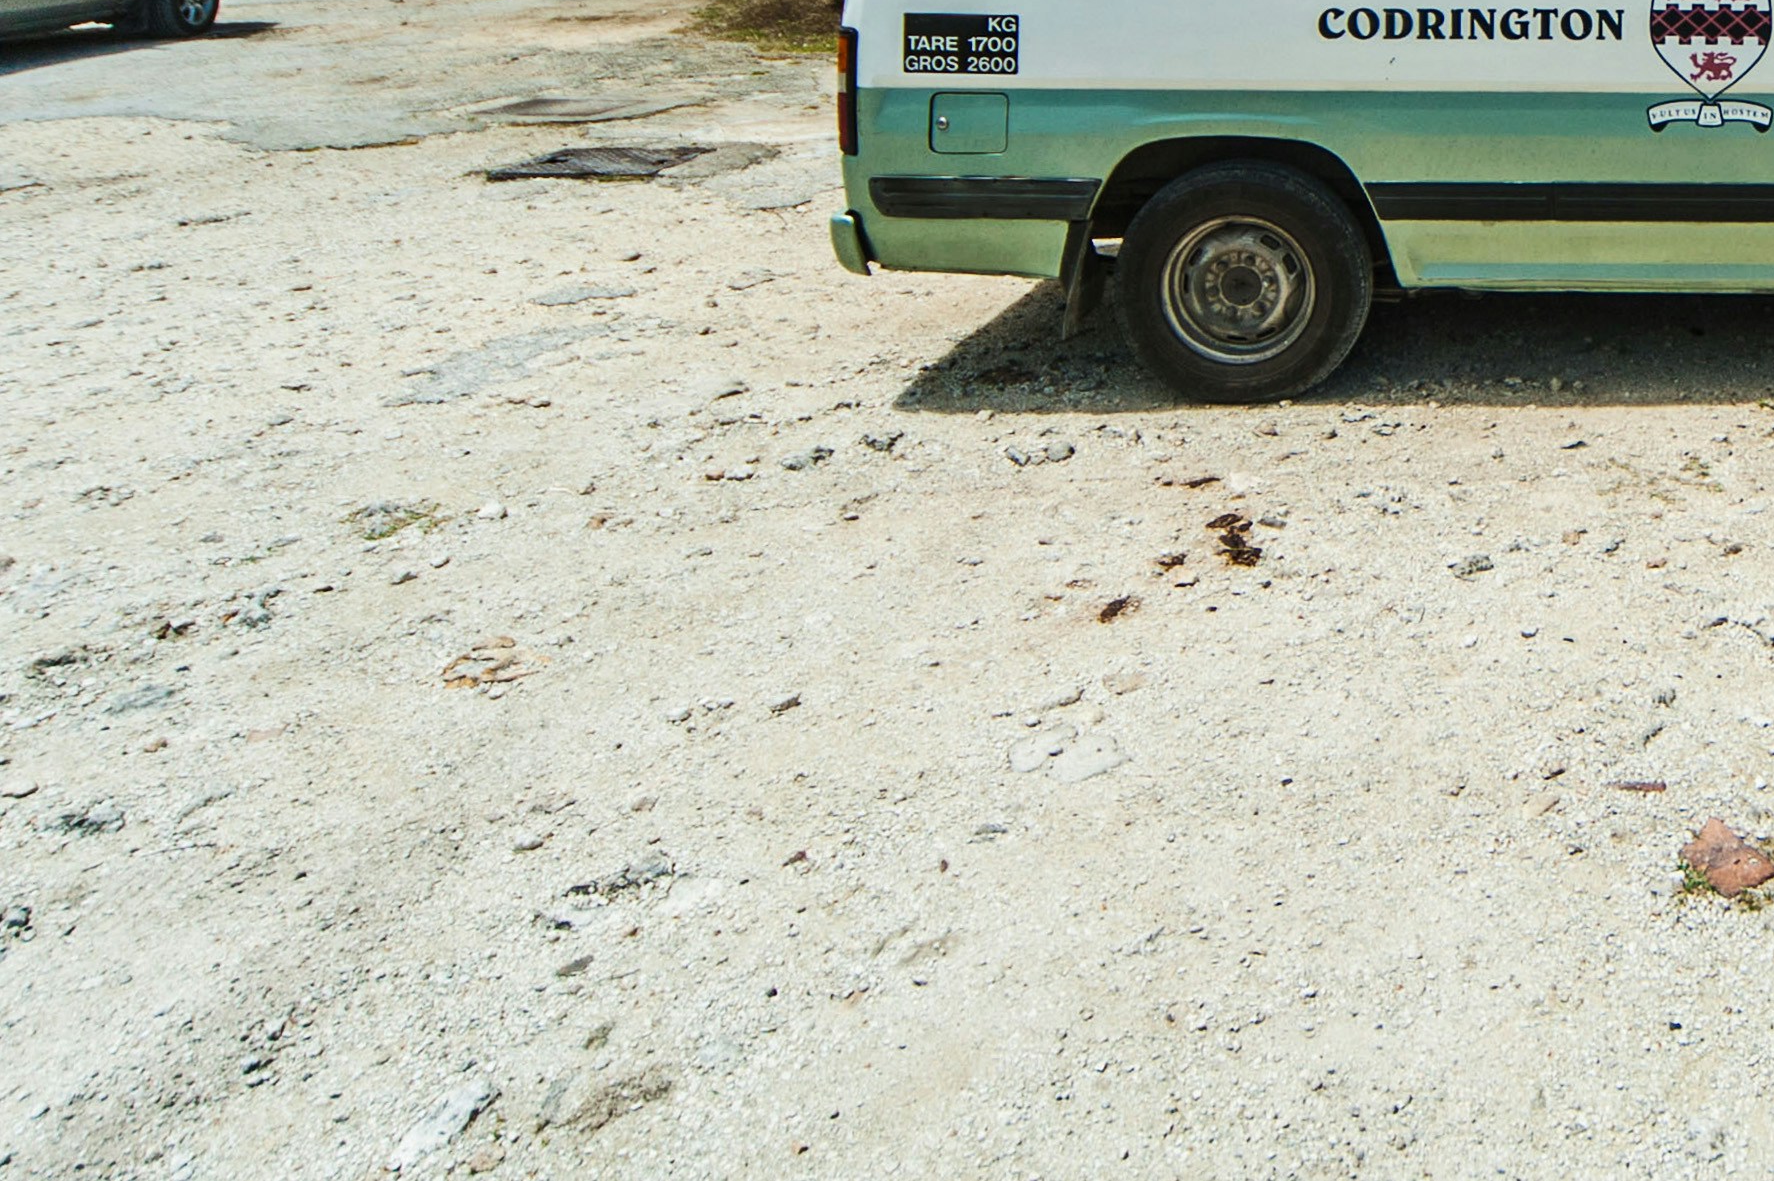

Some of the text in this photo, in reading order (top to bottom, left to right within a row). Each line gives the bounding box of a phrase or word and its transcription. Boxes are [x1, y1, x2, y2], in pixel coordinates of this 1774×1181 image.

[988, 17, 1016, 32] KG
[1318, 8, 1625, 40] CODRINGTON
[907, 35, 1016, 52] TARE 1700
[905, 55, 1016, 72] GROS 2600
[1704, 111, 1717, 119] IN
